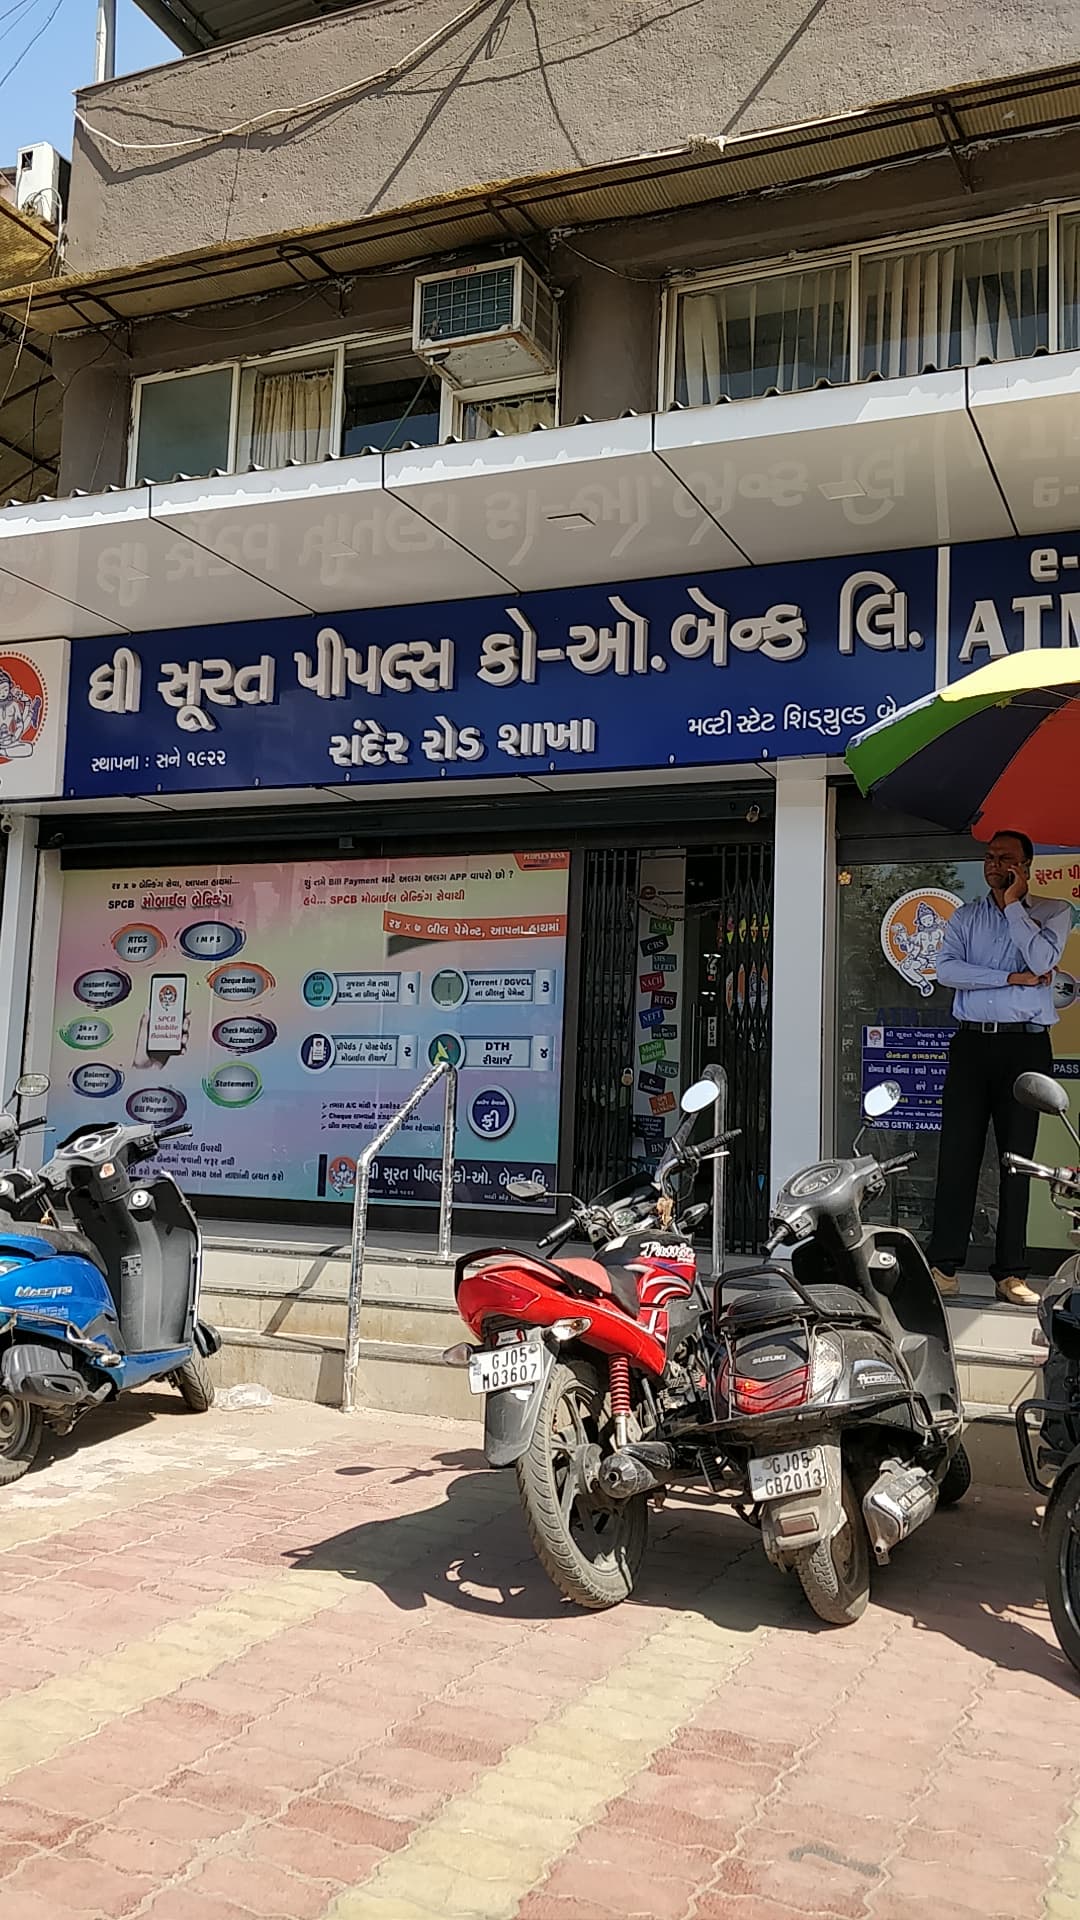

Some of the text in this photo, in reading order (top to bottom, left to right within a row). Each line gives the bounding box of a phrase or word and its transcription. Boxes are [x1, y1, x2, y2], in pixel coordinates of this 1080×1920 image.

[88, 647, 142, 714] ધી
[158, 655, 275, 732] સૂરત
[294, 627, 454, 699] પીપલ્સ
[838, 570, 924, 654] લિ.
[688, 709, 732, 736] મલ્ટી
[737, 707, 776, 732] સ્ટેટ
[329, 716, 595, 767] રાંદેર રોડ શાખા
[91, 756, 139, 772] સ્થાપના
[156, 747, 180, 768] સને
[187, 750, 226, 766] ૧૯૨૨
[328, 878, 342, 886] Bill
[344, 877, 379, 887] Payment
[450, 873, 467, 881] APP
[1035, 868, 1063, 886] સૂરત
[108, 900, 135, 909] SPCB
[141, 893, 187, 908] મોબાઈલ
[330, 895, 357, 904] SPCB
[361, 891, 397, 903] મોબાઈલ
[436, 889, 465, 901] સેવાથી
[427, 924, 449, 935] બીલ
[128, 935, 148, 944] RTGS
[127, 946, 147, 954] NEFT
[646, 940, 665, 952] CBS
[221, 976, 256, 985] Cheque Book
[470, 979, 498, 987] Torrent
[654, 994, 675, 1006] RTGS
[240, 1026, 263, 1034] Multiple
[485, 1042, 510, 1051] DTH
[1053, 1063, 1080, 1074] PASS
[83, 1071, 110, 1079] Balance
[83, 1080, 109, 1089] Enquiry
[215, 1079, 254, 1088] Statement
[141, 1096, 161, 1104] Utility
[134, 1105, 174, 1114] Bill Payment
[383, 1166, 409, 1186] સૂરત
[492, 1347, 528, 1370] GJ05
[752, 1354, 787, 1365] SUZUKI
[772, 1451, 810, 1474] GJ05
[765, 1468, 822, 1496] GB2013
